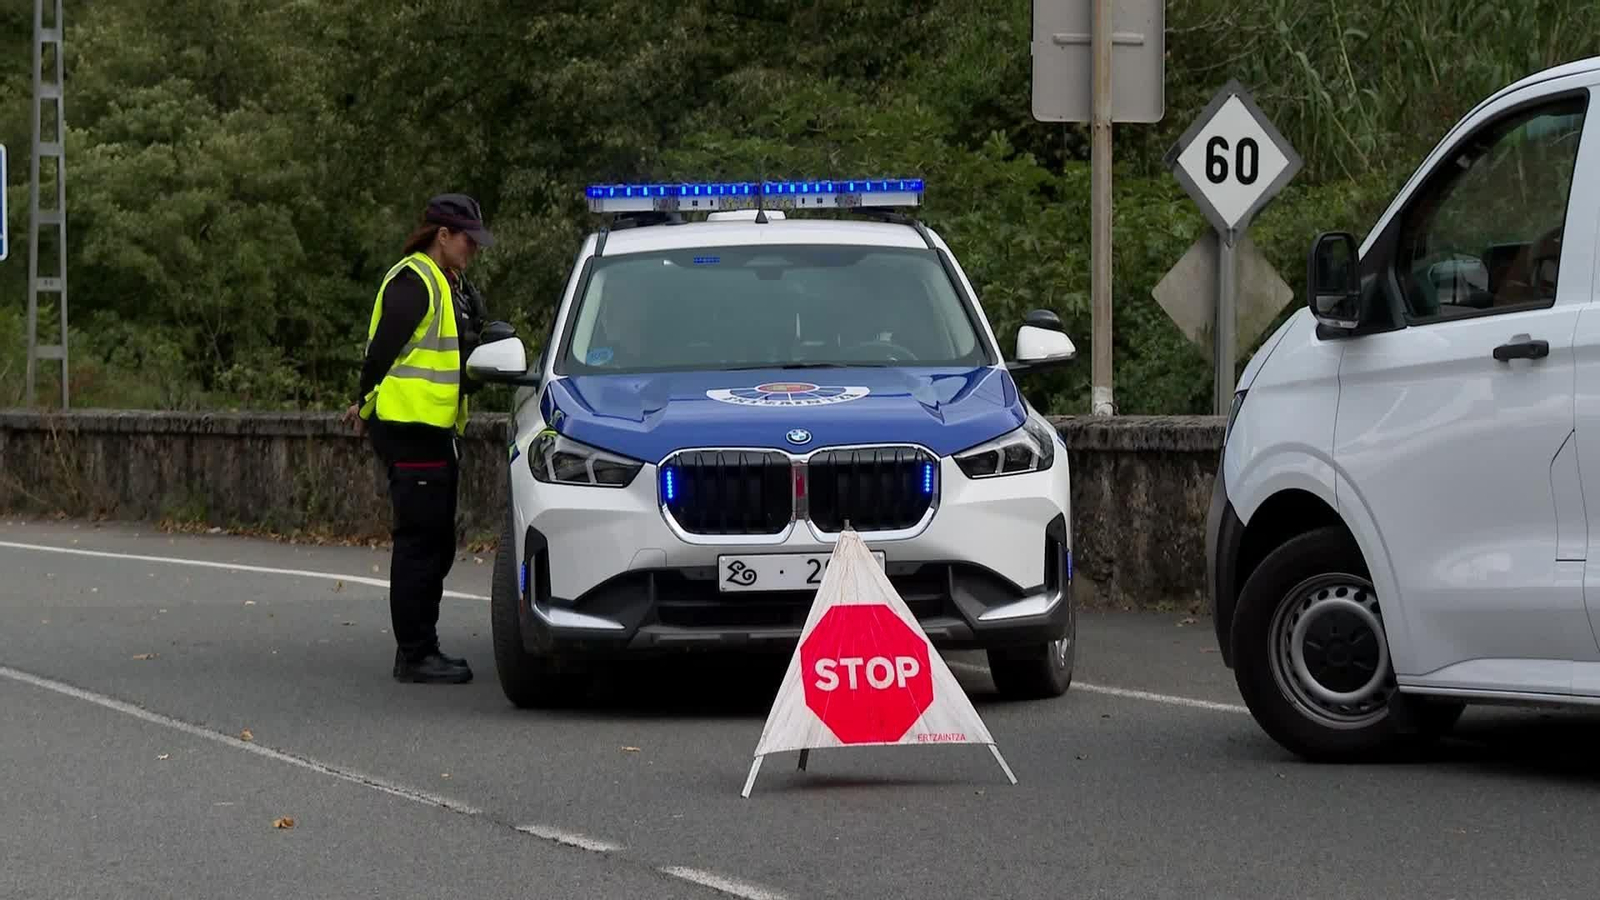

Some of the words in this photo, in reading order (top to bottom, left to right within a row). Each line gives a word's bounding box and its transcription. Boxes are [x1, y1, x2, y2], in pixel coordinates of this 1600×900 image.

[1205, 136, 1259, 186] 60
[814, 656, 920, 692] STOP
[917, 733, 966, 742] ERTZAINTZA
